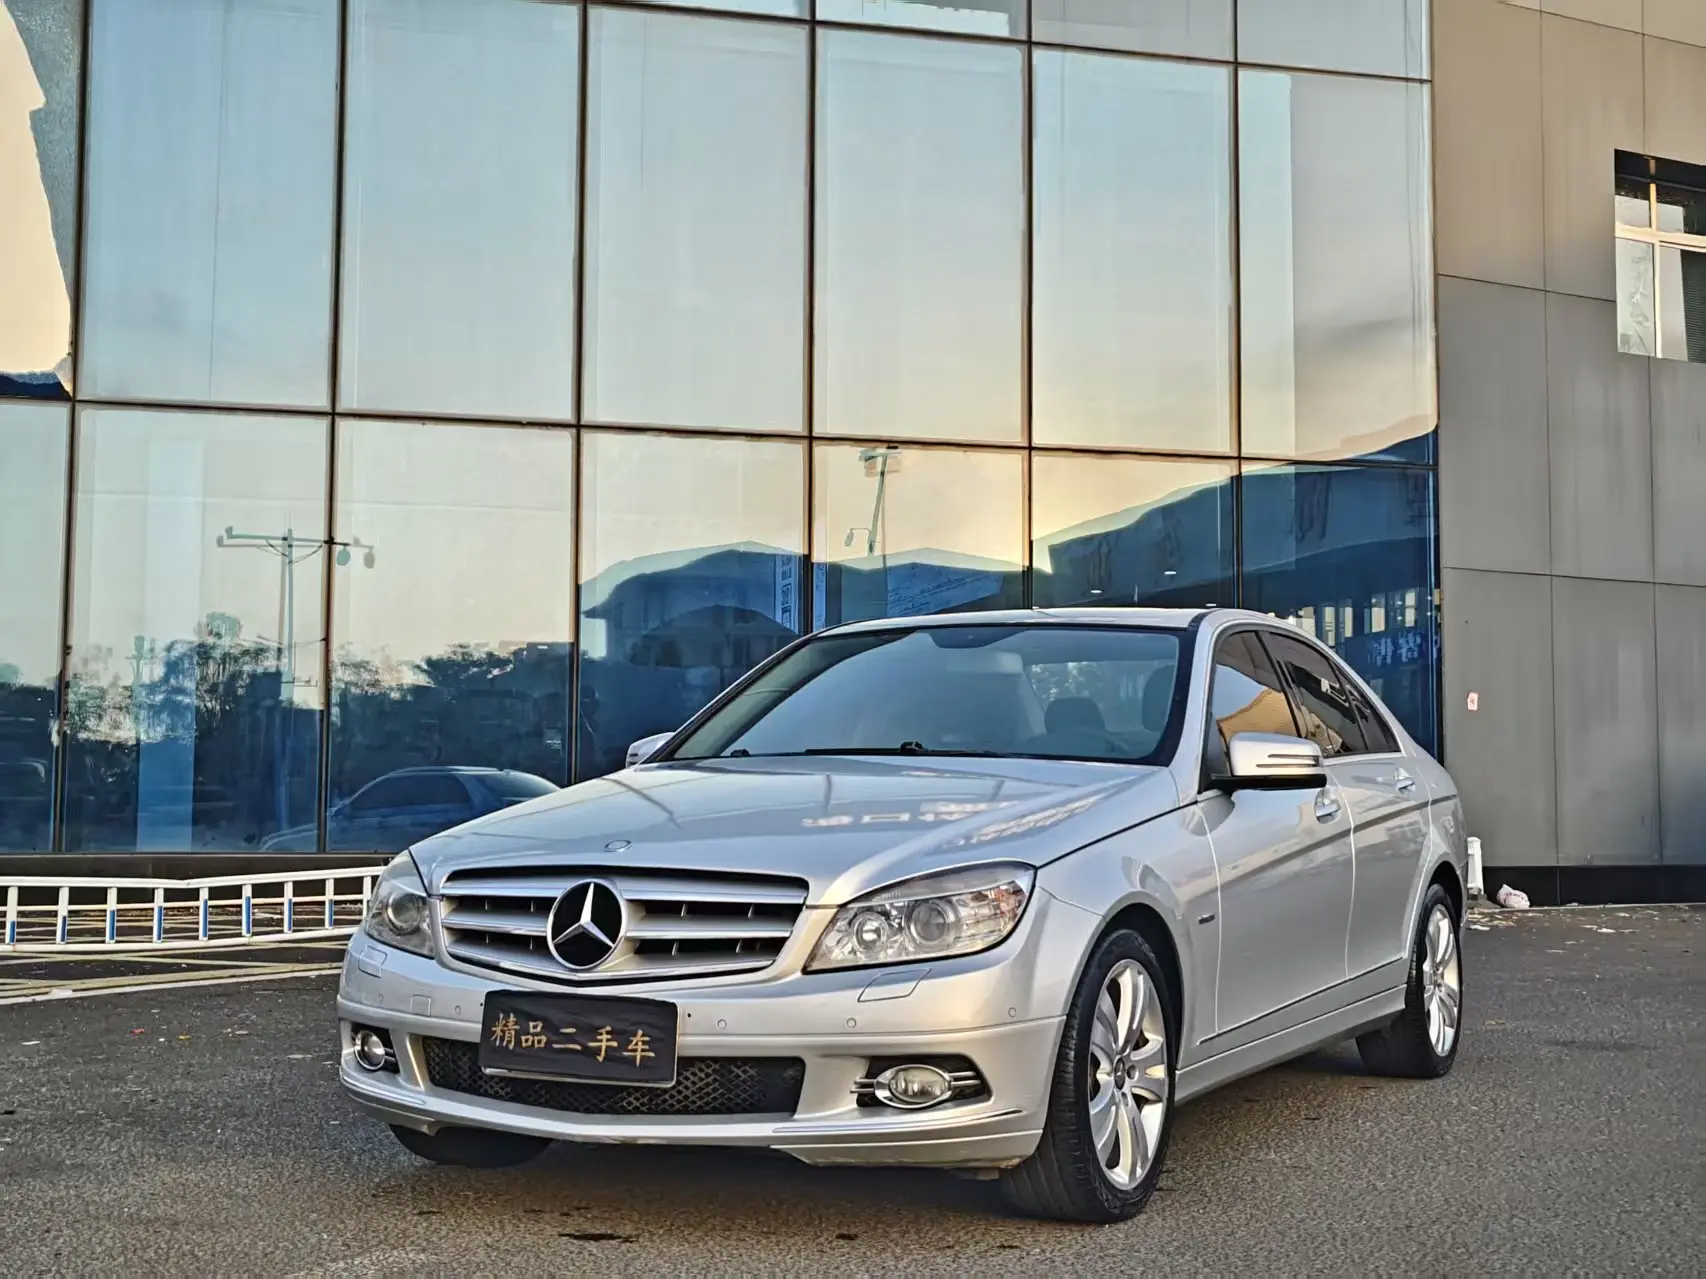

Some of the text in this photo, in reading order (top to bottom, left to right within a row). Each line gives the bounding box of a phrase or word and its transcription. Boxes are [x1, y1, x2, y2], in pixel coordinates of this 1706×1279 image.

[490, 1012, 656, 1067] 精品二手车
